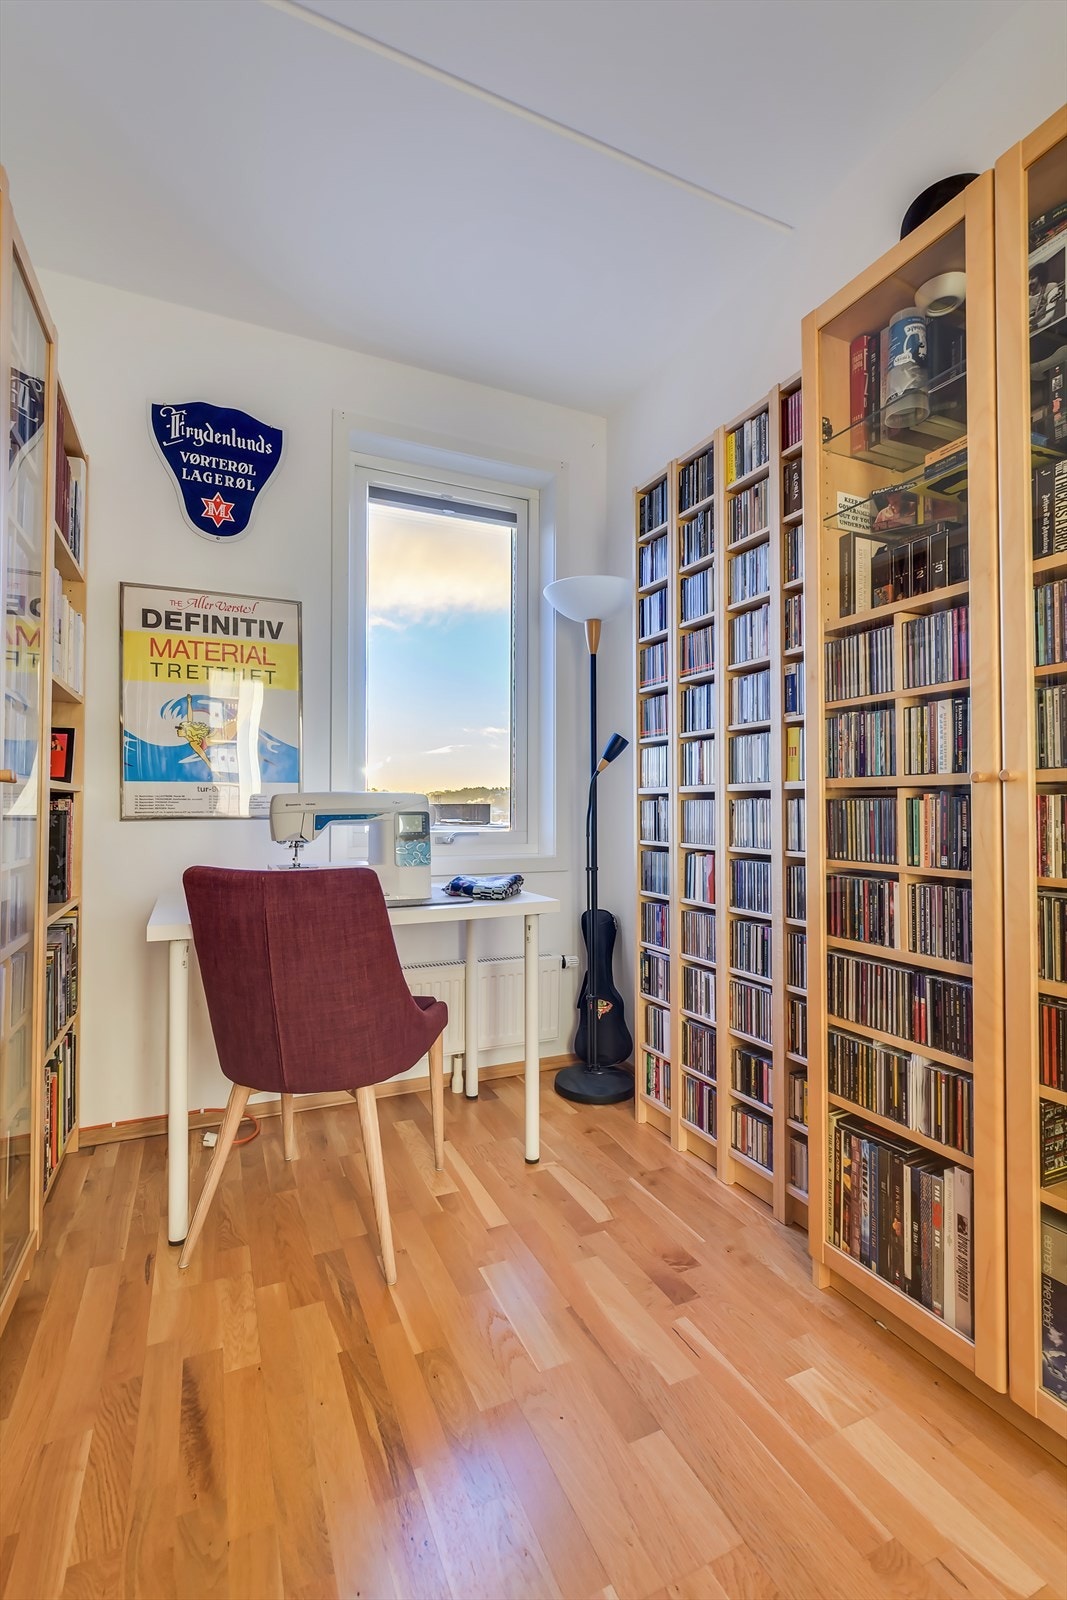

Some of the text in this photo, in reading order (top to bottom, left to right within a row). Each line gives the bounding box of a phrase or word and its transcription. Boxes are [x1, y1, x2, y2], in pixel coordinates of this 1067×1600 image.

[160, 406, 272, 454] Frydenlunds
[180, 451, 256, 476] VØRTERØL
[182, 468, 255, 492] LAGERØL
[142, 608, 284, 640] DEFINITIV
[150, 637, 276, 666] MATERIAL
